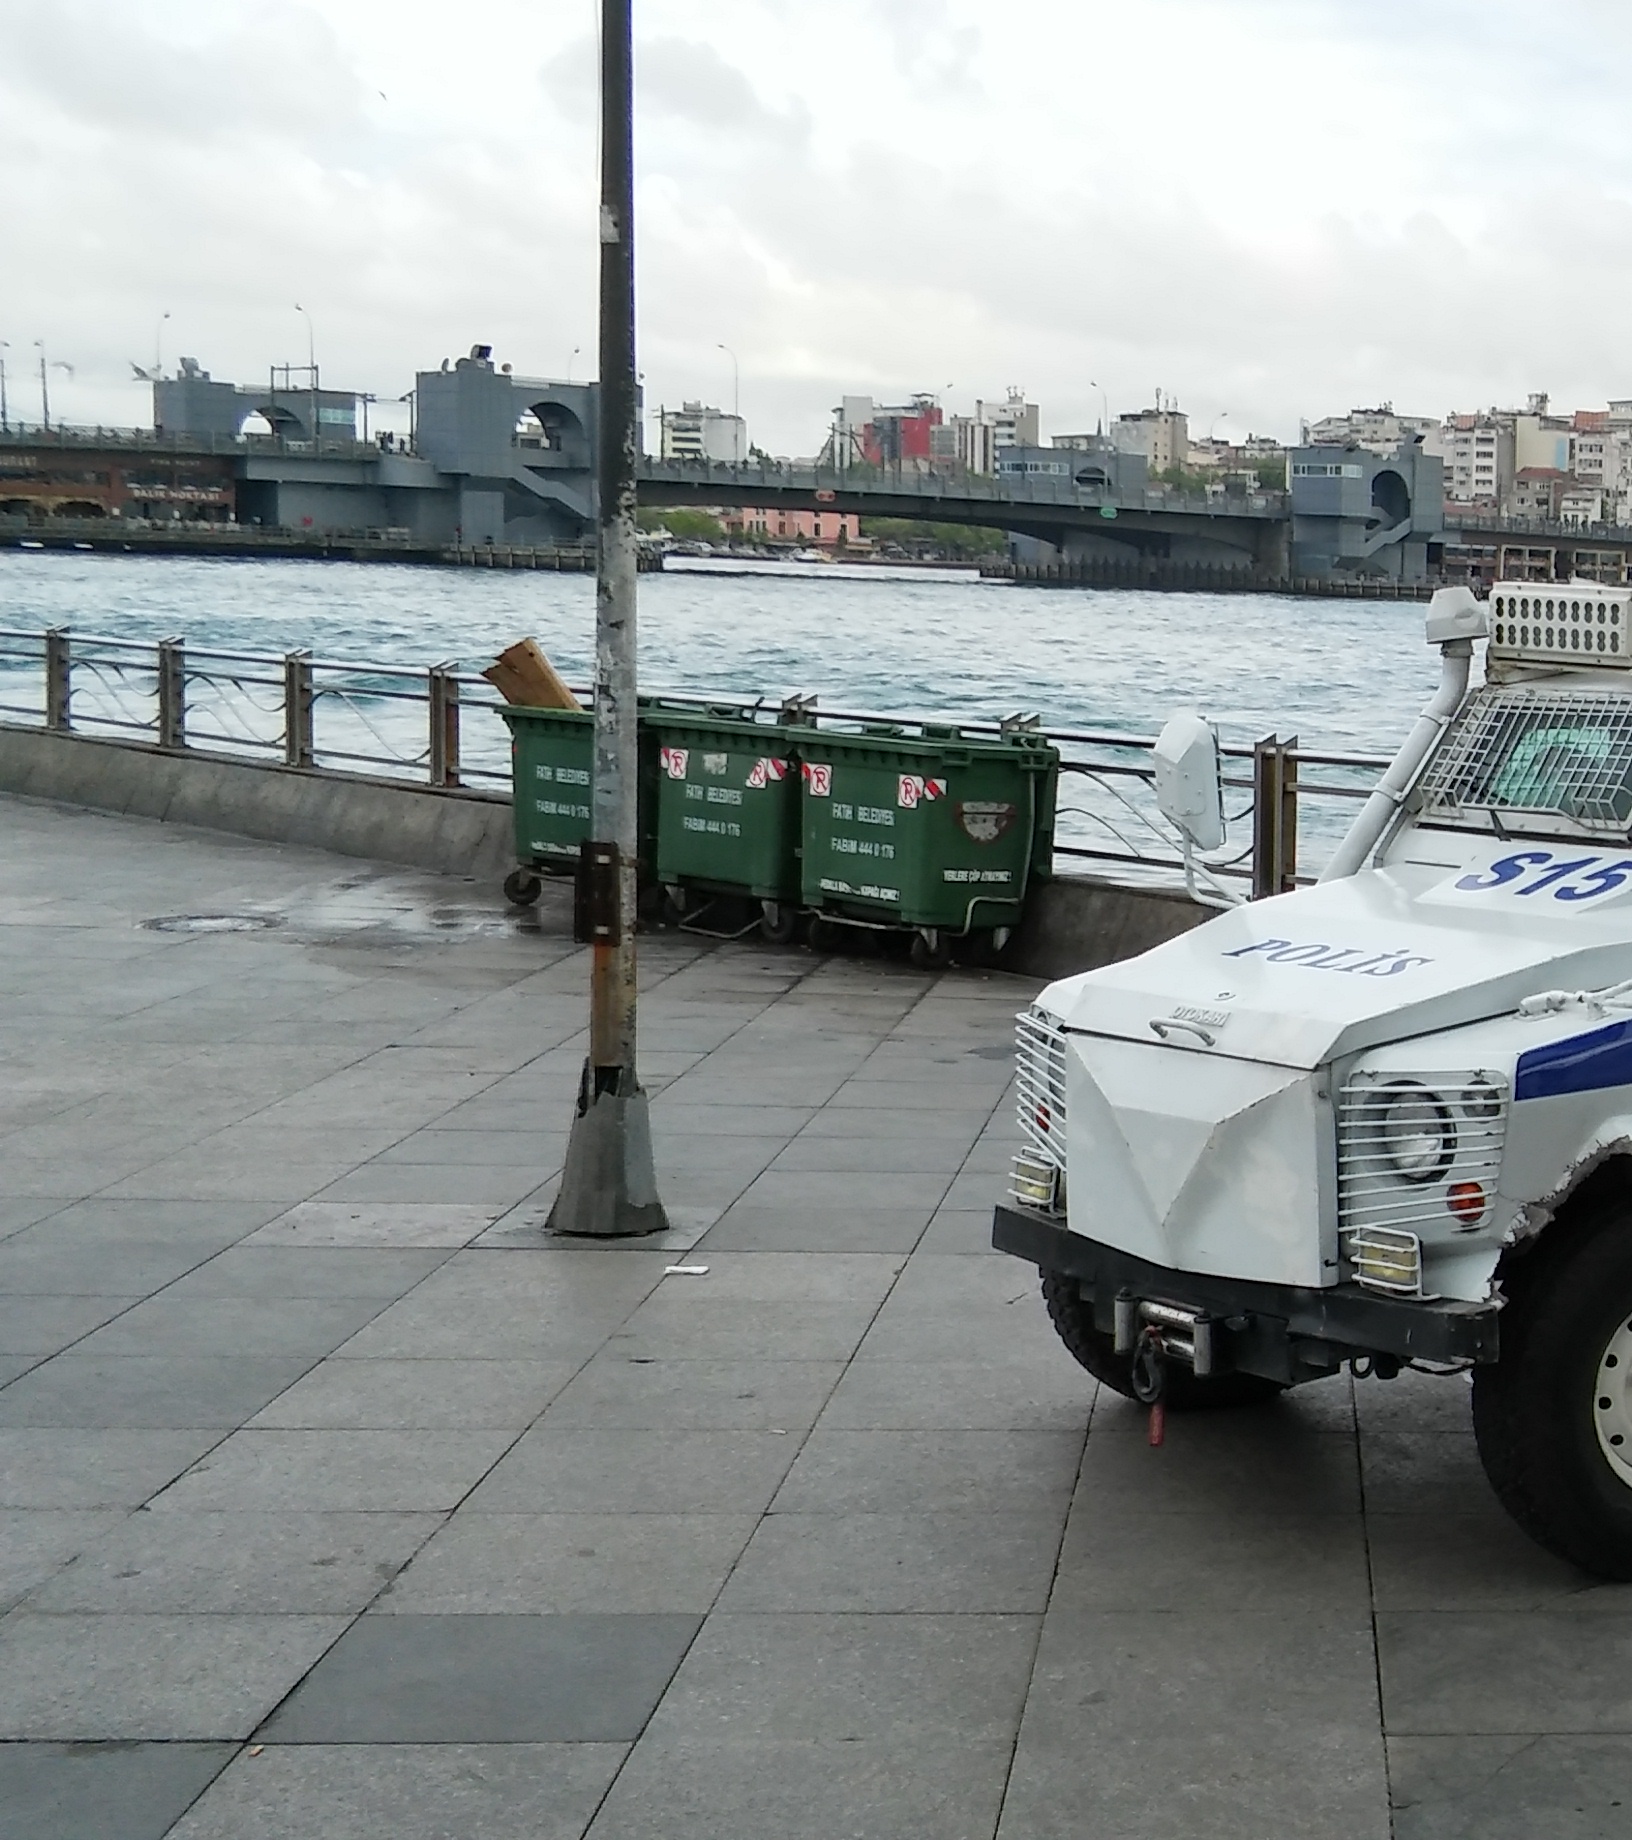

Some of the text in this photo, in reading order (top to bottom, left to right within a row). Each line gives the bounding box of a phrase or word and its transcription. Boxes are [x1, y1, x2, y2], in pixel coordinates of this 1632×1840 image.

[858, 841, 873, 855] 444
[881, 844, 895, 860] 176
[1222, 937, 1435, 979] POLİS
